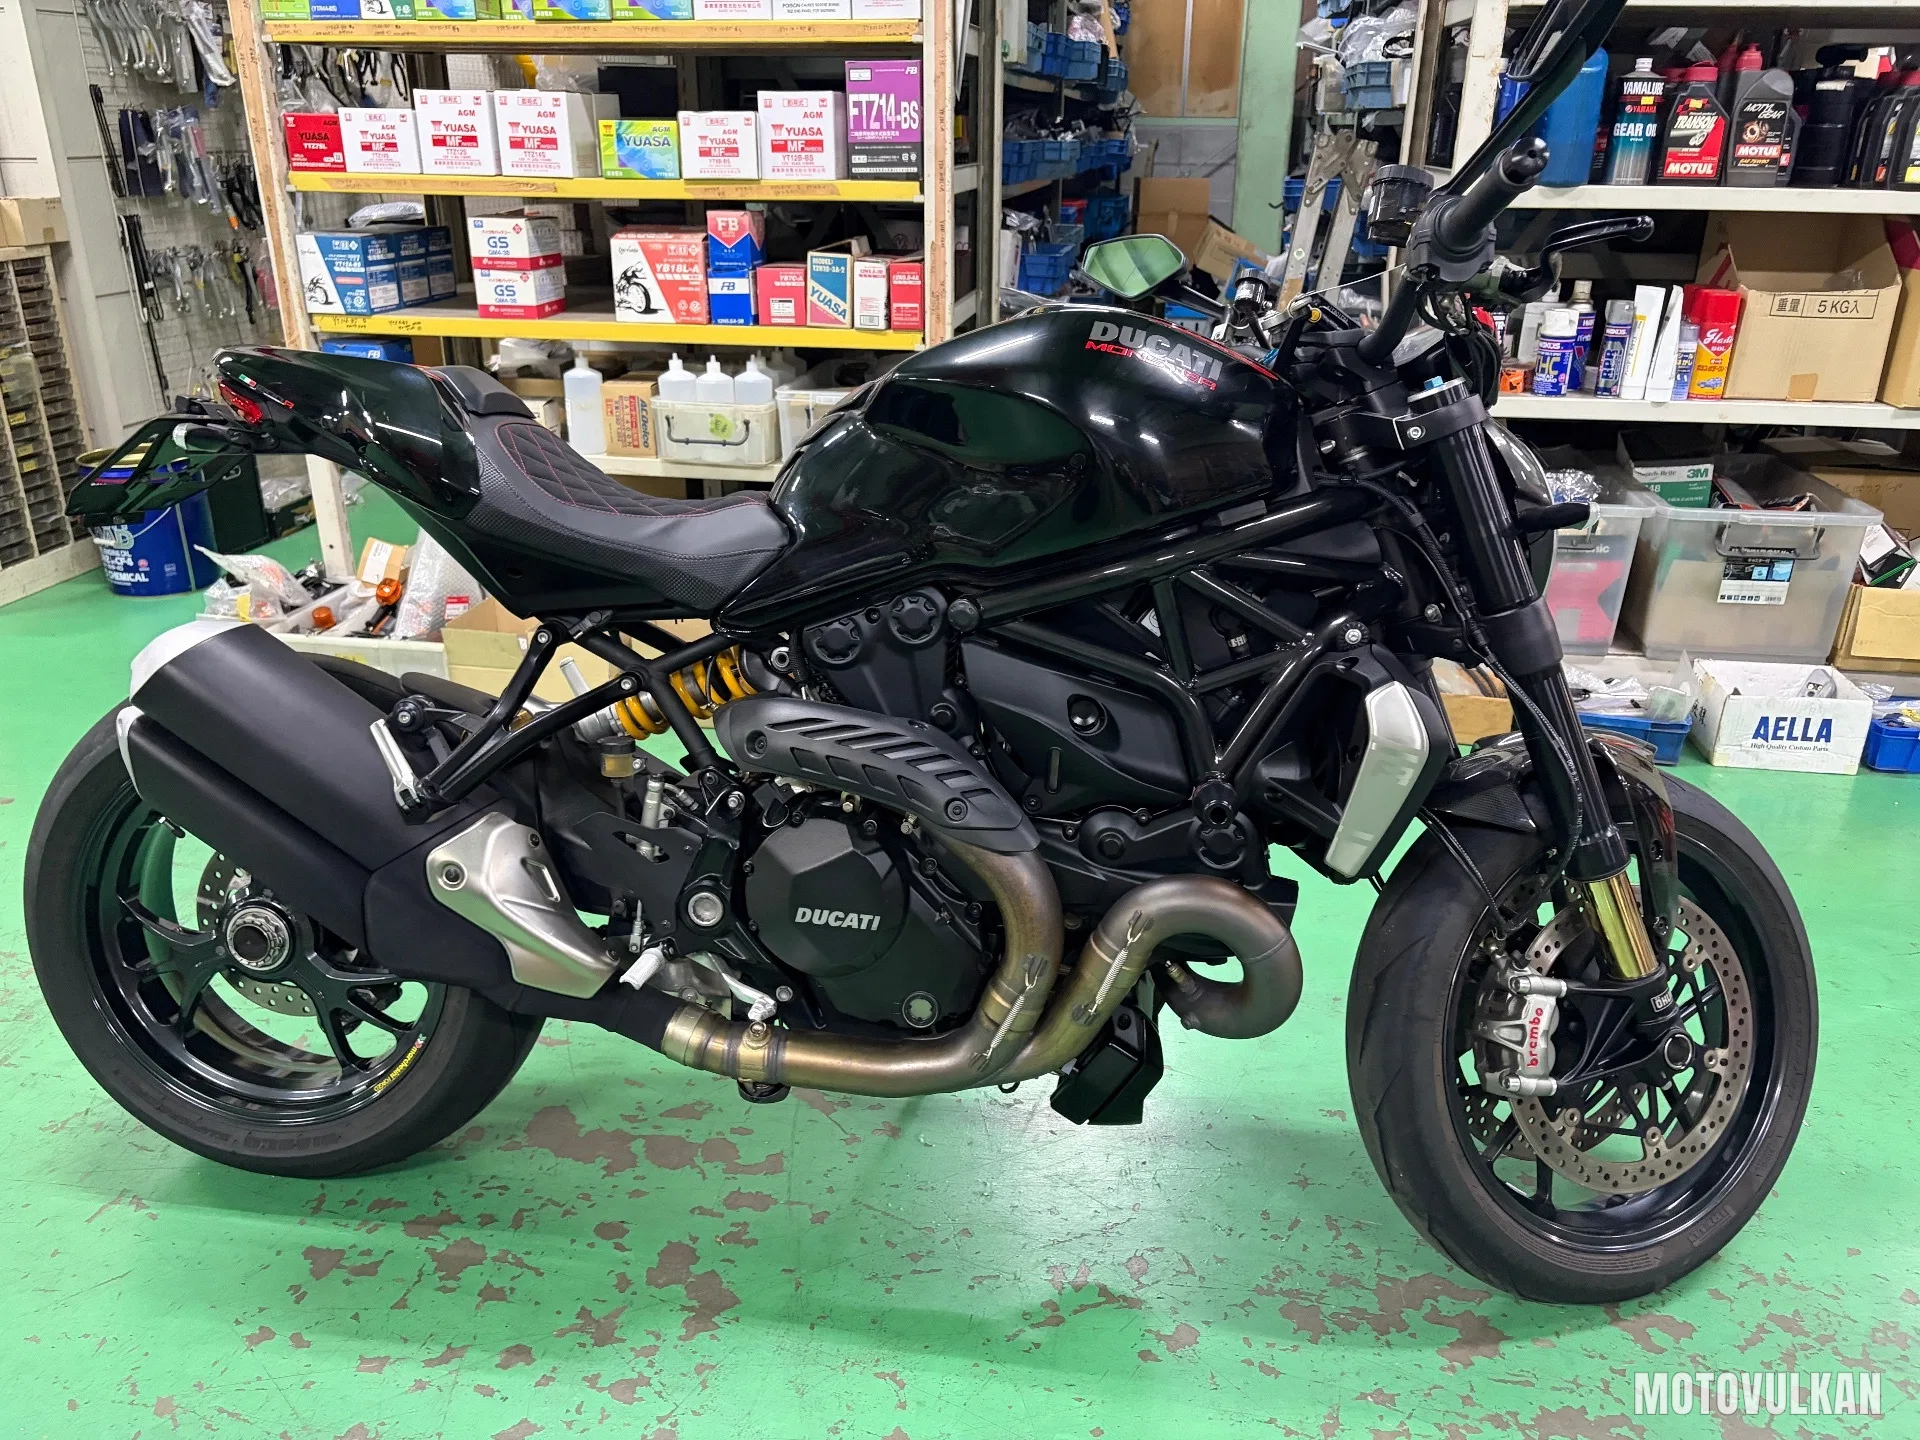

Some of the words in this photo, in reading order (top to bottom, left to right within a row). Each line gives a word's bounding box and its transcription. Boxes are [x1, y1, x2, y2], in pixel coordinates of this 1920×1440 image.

[905, 66, 918, 75] FB
[849, 93, 919, 130] FTZ14-BS
[1633, 105, 1656, 113] YAMAHA
[803, 111, 823, 119] AGM
[443, 124, 477, 132] YUASA
[522, 125, 557, 135] YUASA
[785, 127, 823, 136] YUASA
[1613, 122, 1644, 137] GEAR
[298, 132, 330, 141] YUASA
[370, 132, 397, 141] YUASA
[446, 135, 462, 147] MF
[624, 136, 671, 147] YUASA
[709, 138, 738, 146] YUASA
[372, 142, 386, 151] MF
[524, 137, 541, 149] MF
[787, 140, 805, 153] MF
[711, 146, 725, 157] MF
[1736, 146, 1779, 156] MOTUL
[782, 154, 814, 162] YT12B-BS
[1666, 163, 1714, 175] MOTUL
[716, 217, 739, 232] FB
[487, 236, 509, 249] GS
[655, 263, 700, 273] YB18L-A
[494, 285, 516, 297] GS
[720, 281, 736, 291] FB
[811, 286, 847, 319] YUASA
[1776, 298, 1800, 313] 重量
[1089, 320, 1224, 382] DUCATI
[1687, 468, 1708, 478] 3M
[1751, 716, 1833, 743] AELLA
[795, 907, 881, 931] DUCATI
[1527, 1007, 1544, 1068] brembo
